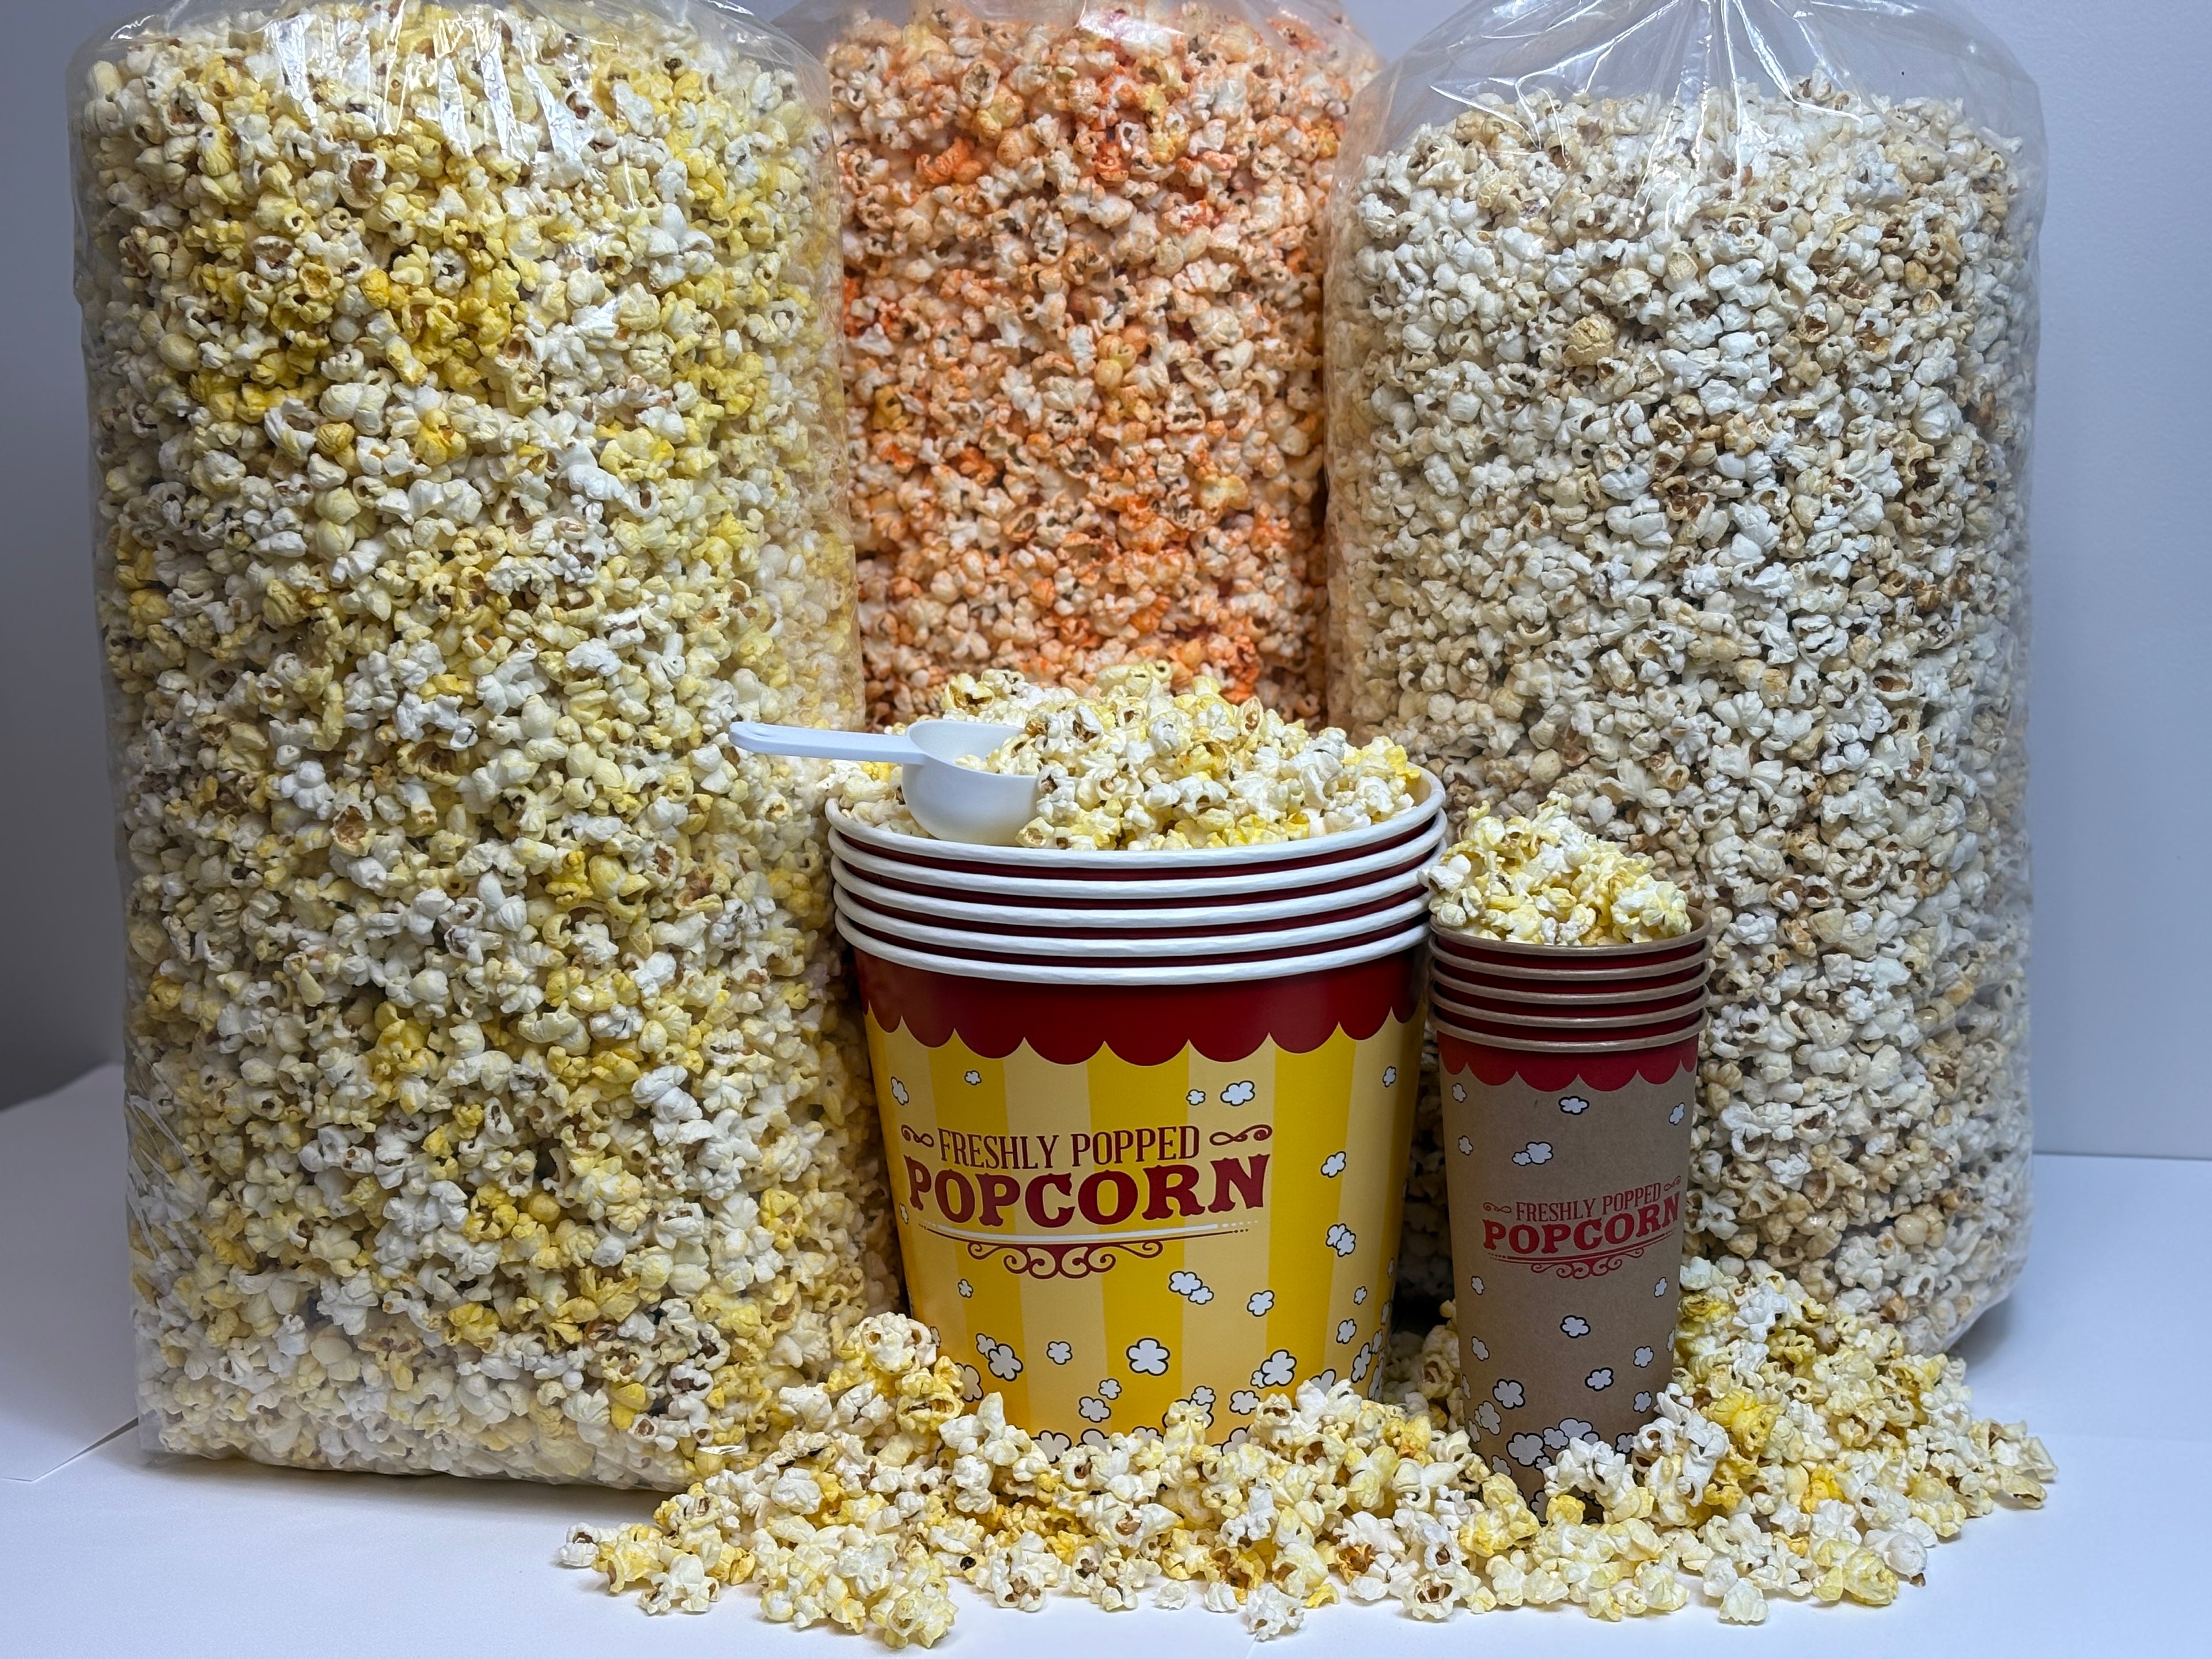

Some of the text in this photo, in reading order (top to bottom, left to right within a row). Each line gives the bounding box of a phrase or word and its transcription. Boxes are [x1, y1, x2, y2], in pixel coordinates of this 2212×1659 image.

[938, 1125, 1200, 1170] FRESHLY POPPED
[903, 1153, 1271, 1228] POPCORN
[1516, 1182, 1661, 1222] FRESHLY POPPED
[1482, 1191, 1680, 1254] POPCORN
